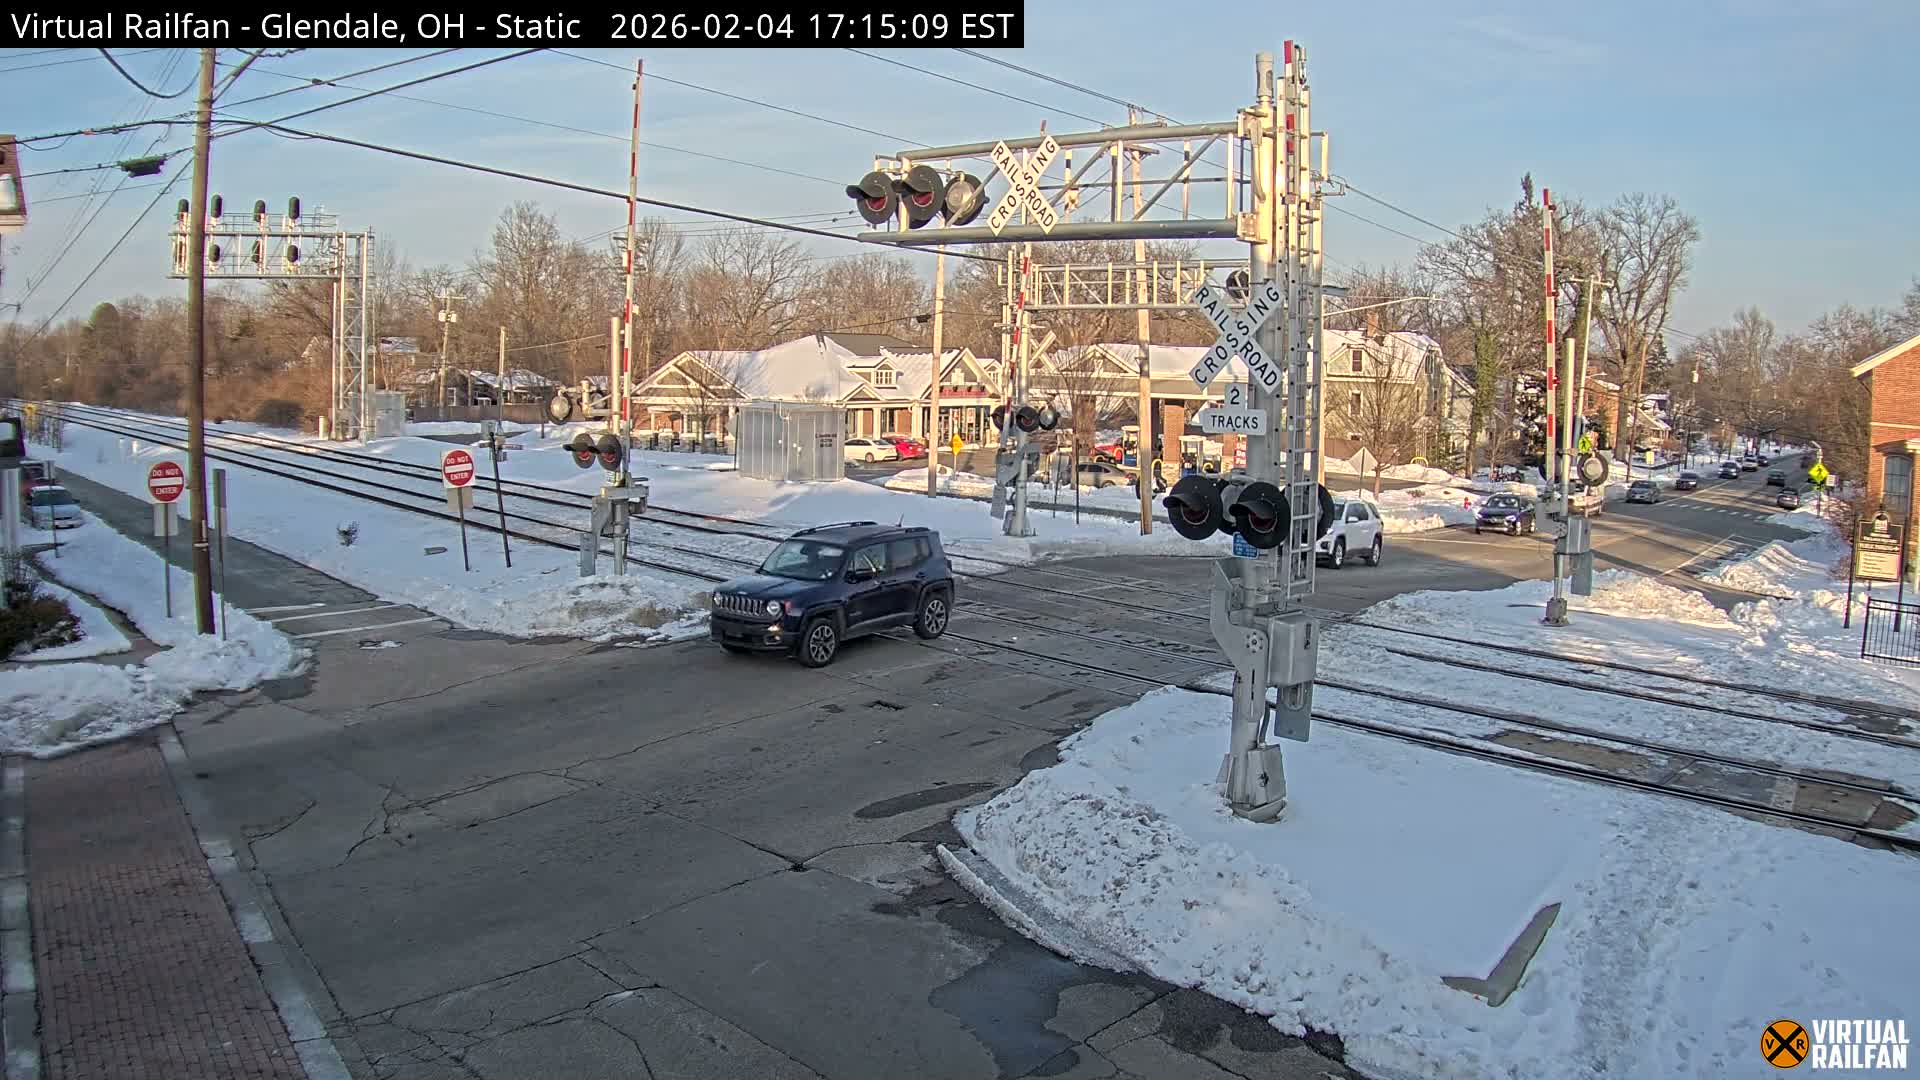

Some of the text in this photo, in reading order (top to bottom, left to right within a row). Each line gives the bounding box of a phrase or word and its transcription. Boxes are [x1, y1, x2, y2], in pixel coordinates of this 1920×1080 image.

[991, 140, 1056, 229] CROSSING
[1194, 286, 1280, 384] CROSSING
[1229, 388, 1240, 405] 2
[1210, 414, 1259, 430] TRACKS
[446, 455, 469, 465] DO NOT
[152, 468, 179, 477] DO NOT
[450, 472, 469, 481] ENTER
